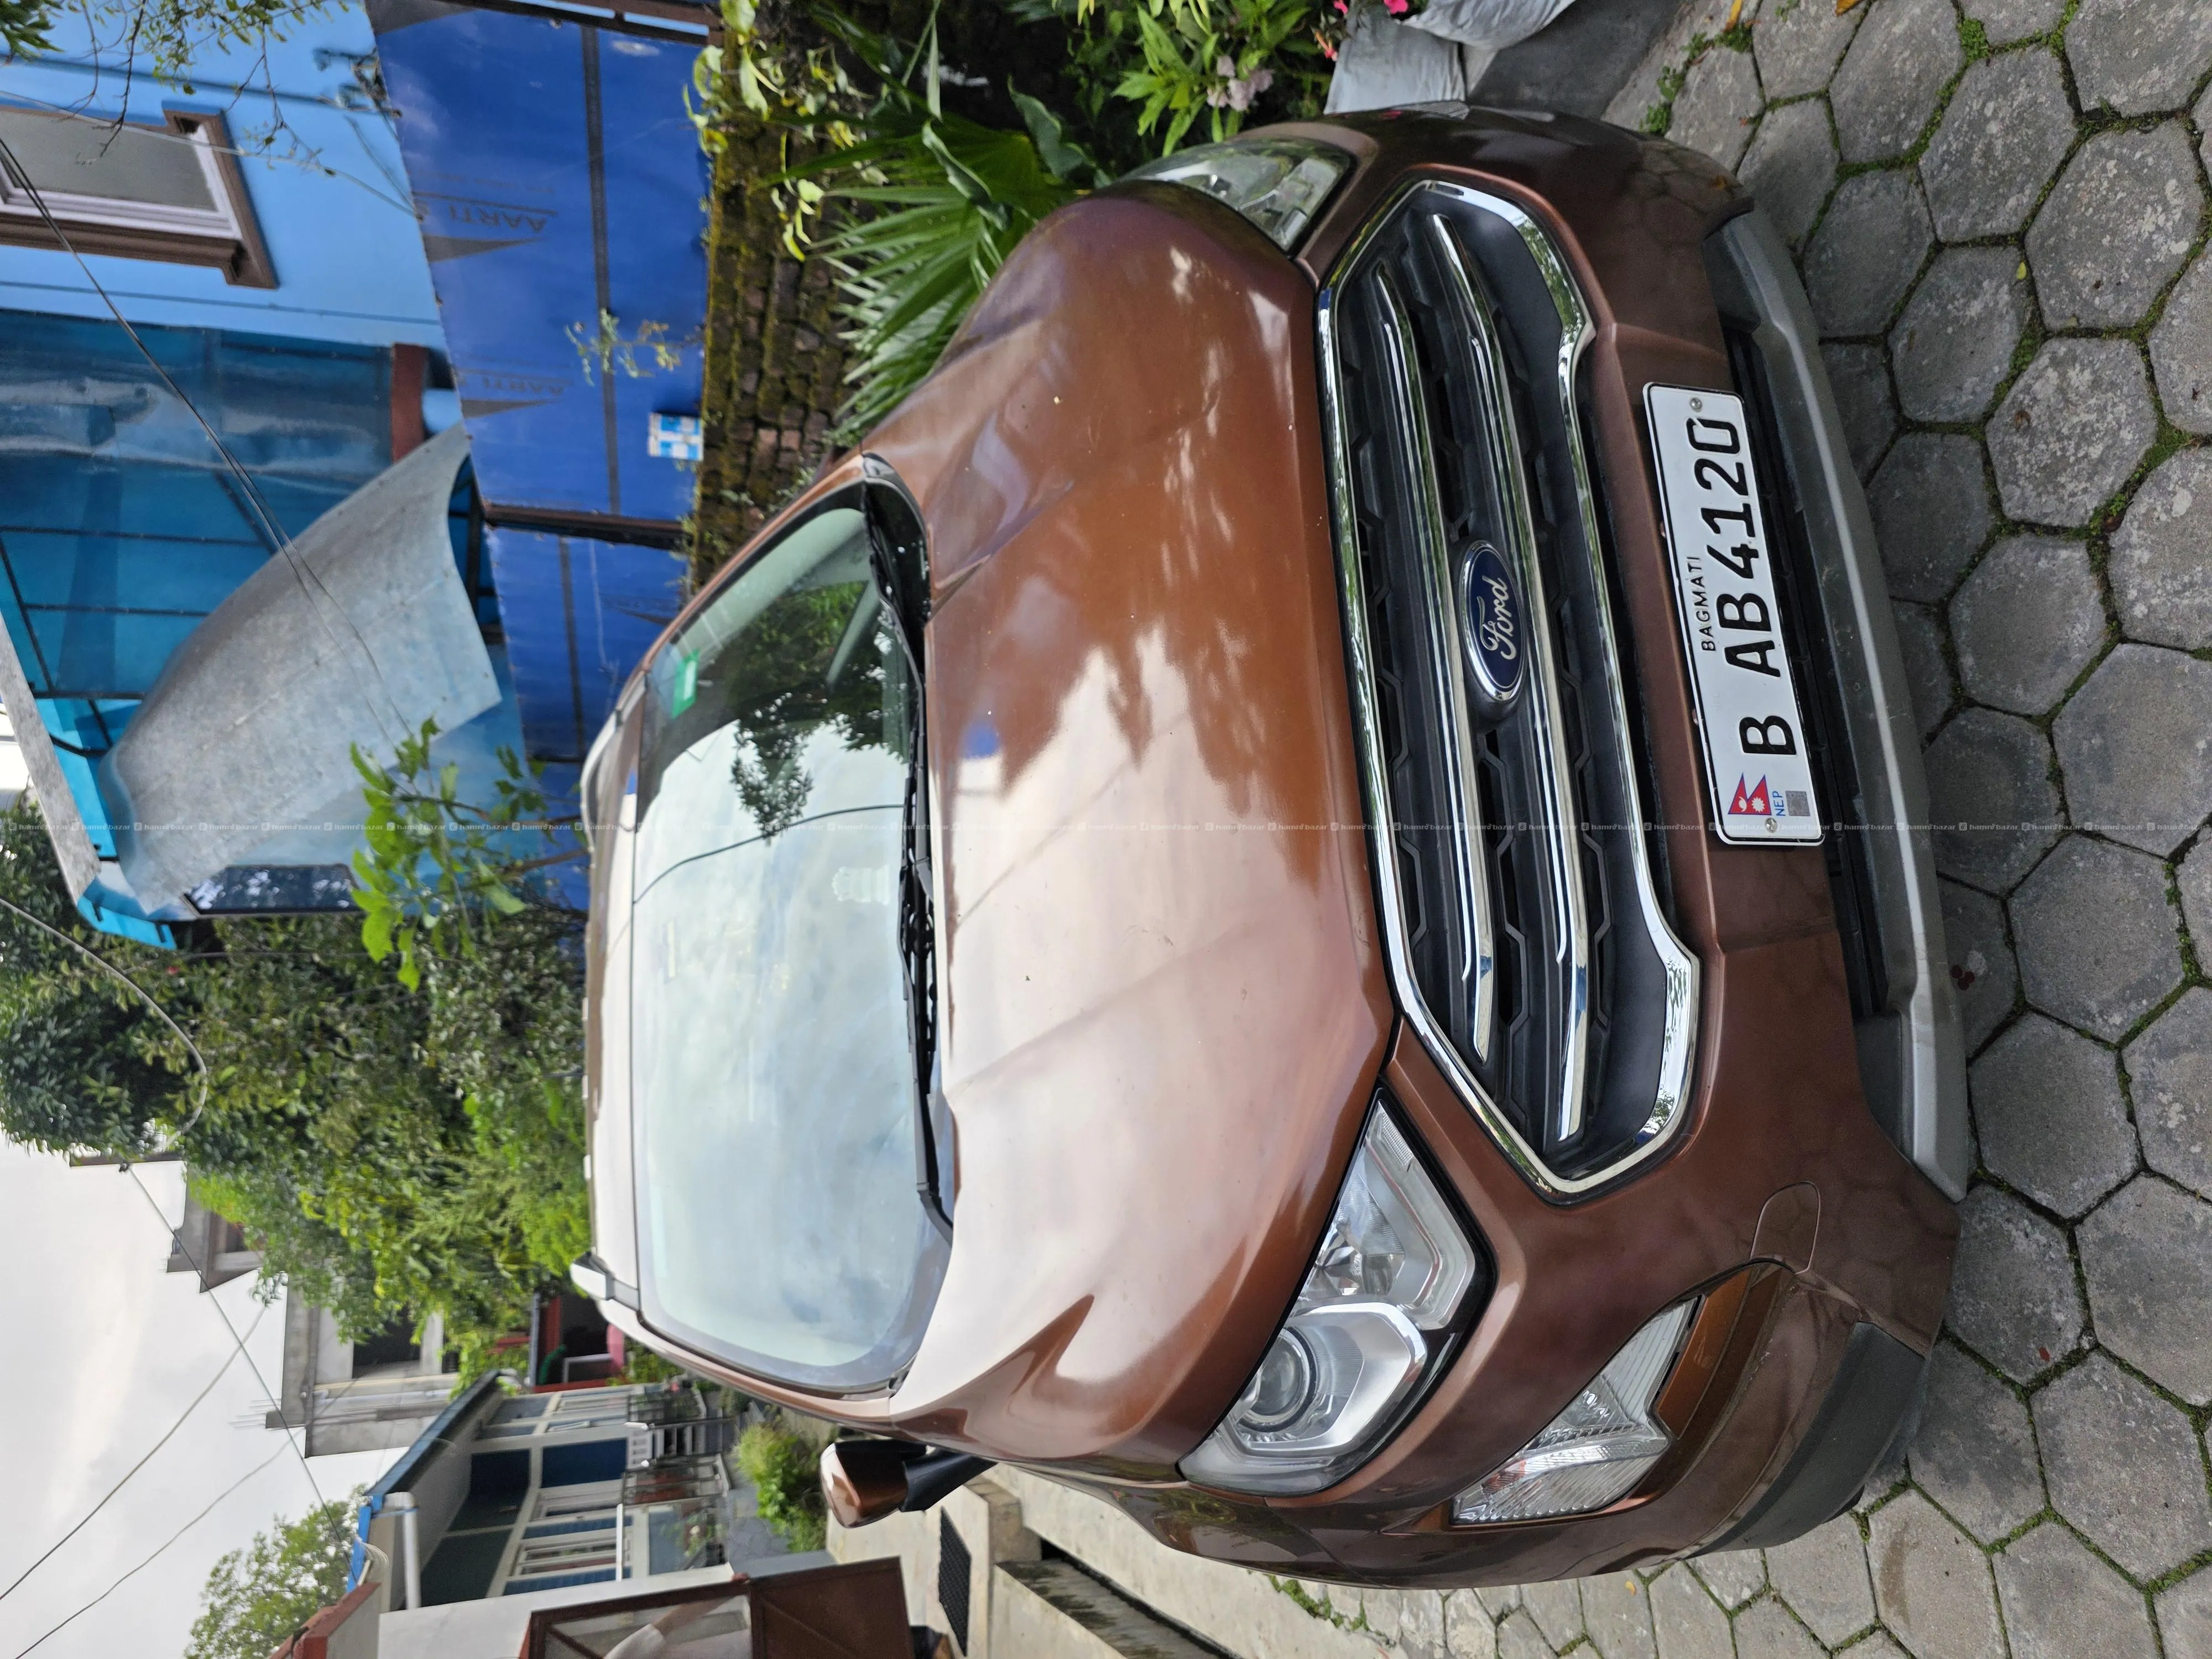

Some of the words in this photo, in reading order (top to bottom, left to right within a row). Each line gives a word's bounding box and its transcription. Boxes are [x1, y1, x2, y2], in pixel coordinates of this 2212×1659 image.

[1477, 575, 1517, 659] Ford
[1686, 555, 1716, 650] BAGMATI
[1739, 715, 1797, 755] B
[1772, 790, 1786, 816] NEP
